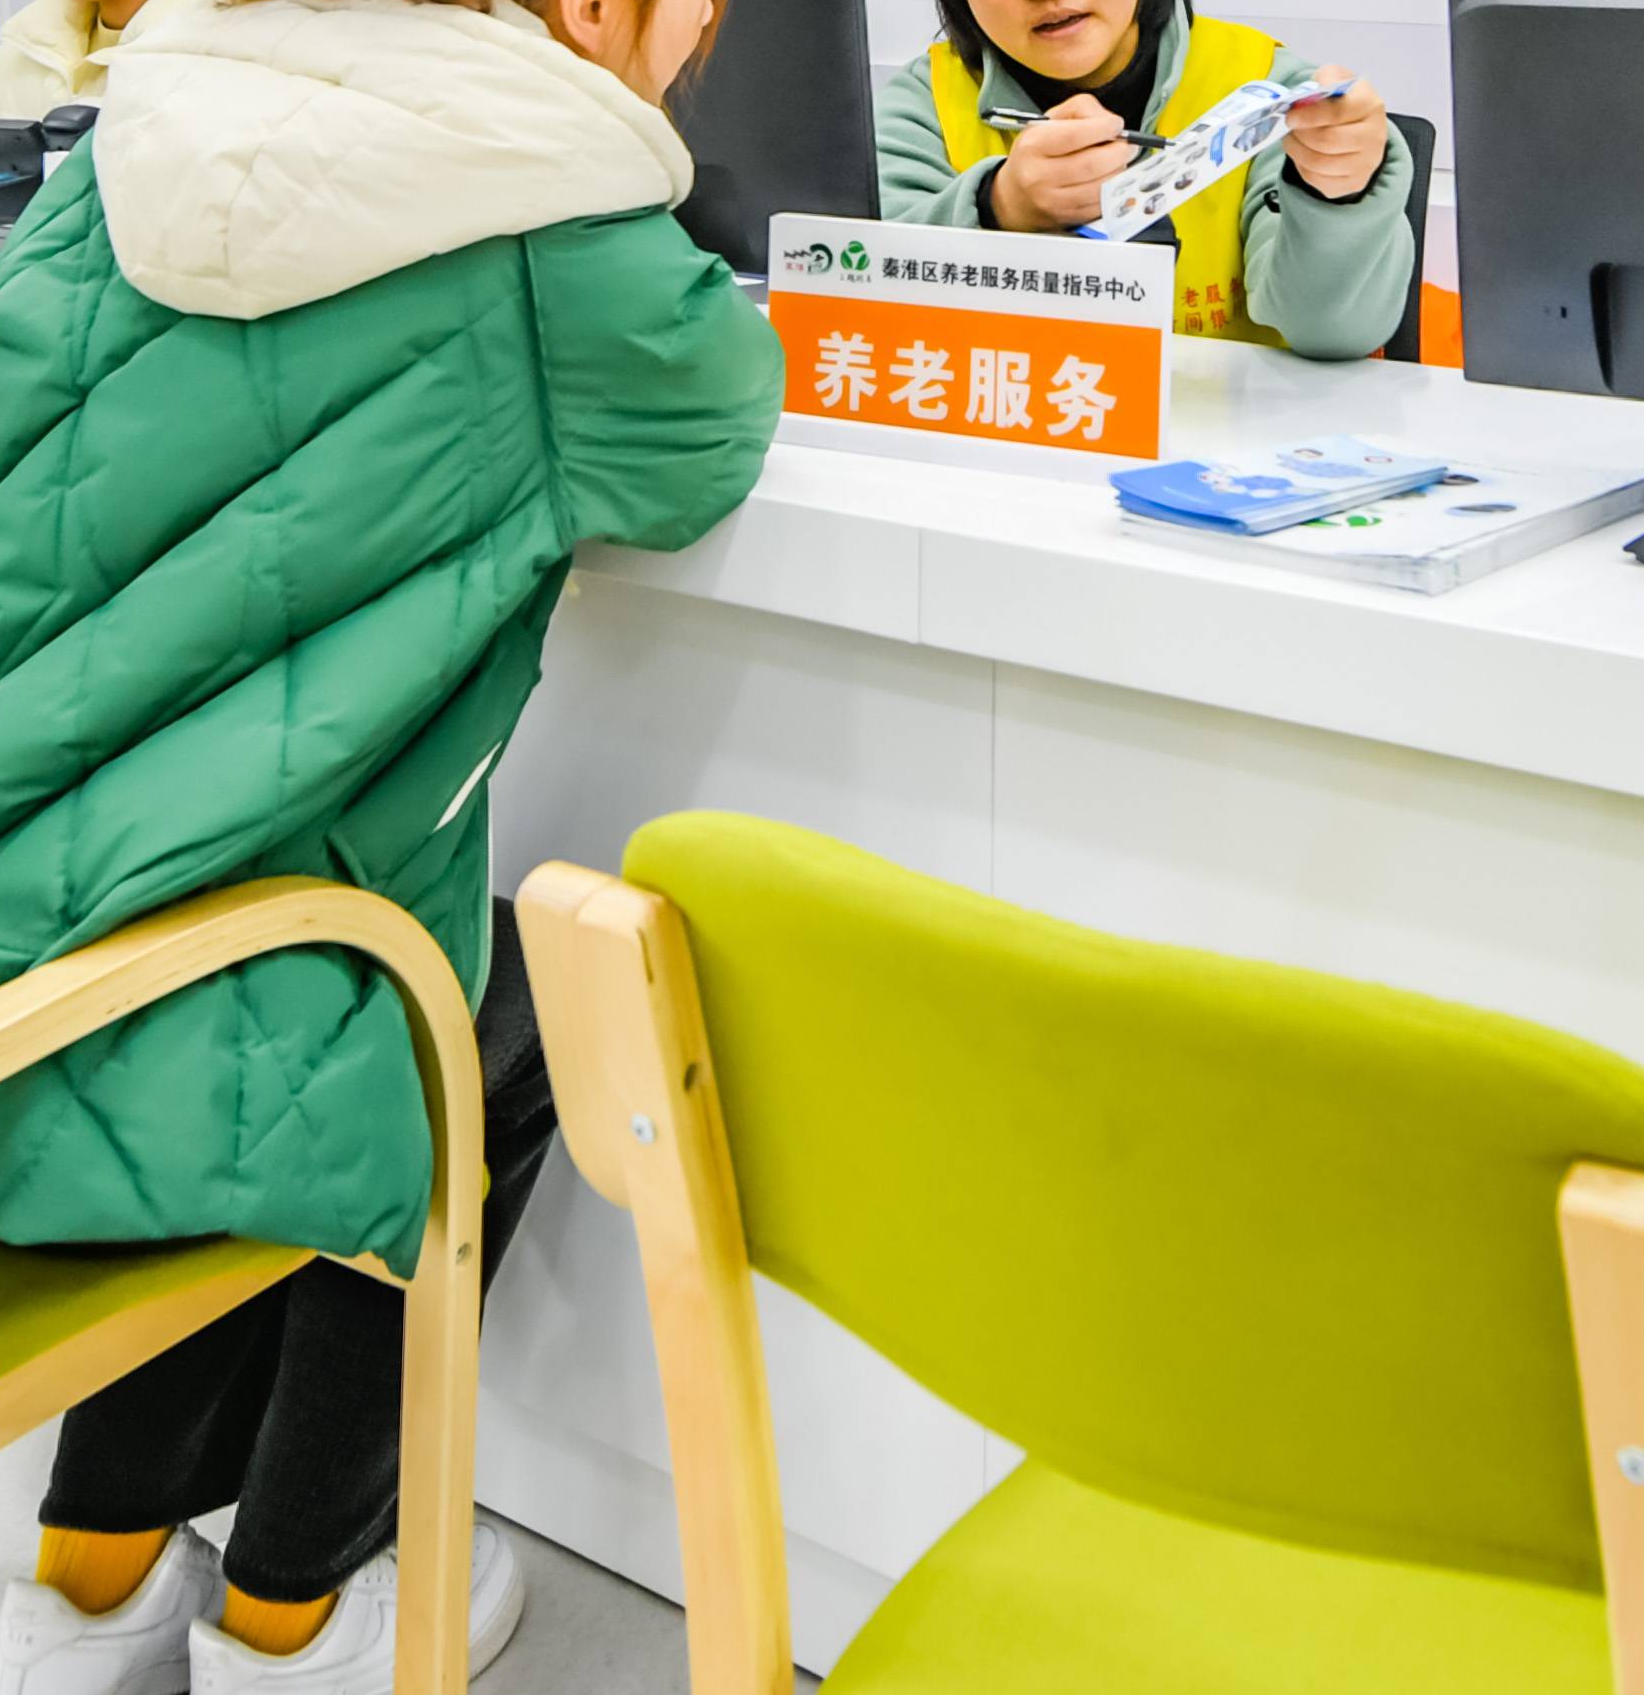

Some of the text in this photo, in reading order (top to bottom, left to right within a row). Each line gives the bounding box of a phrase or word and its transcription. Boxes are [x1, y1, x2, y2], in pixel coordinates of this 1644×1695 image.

[882, 256, 1147, 303] 秦淮区养老服务质量指导中心
[813, 331, 1118, 441] 养老服务
